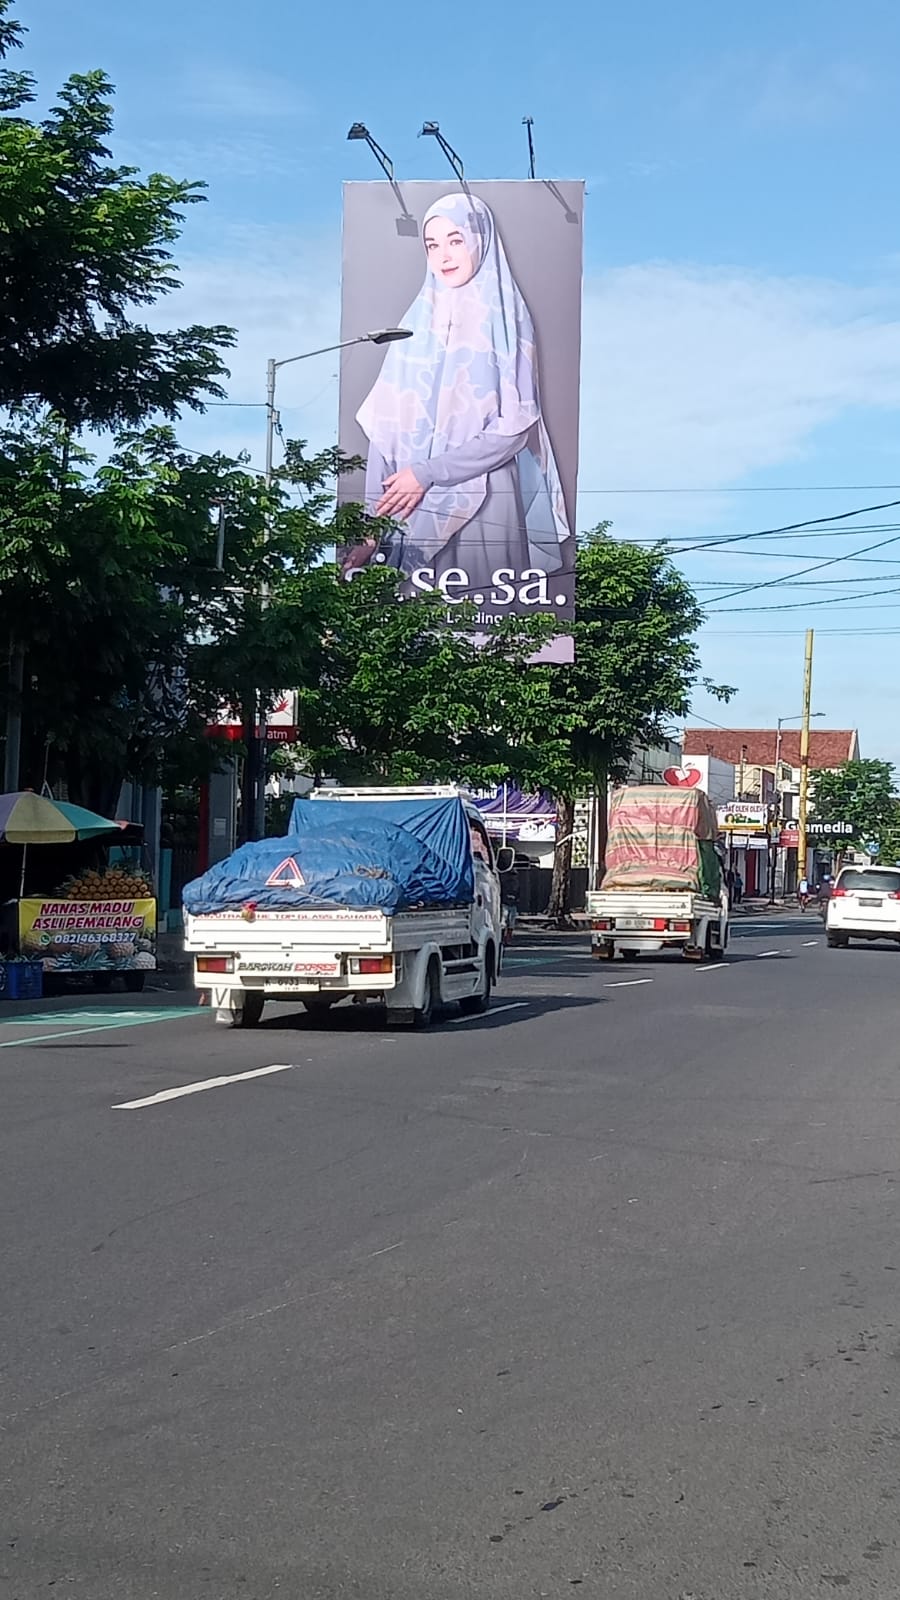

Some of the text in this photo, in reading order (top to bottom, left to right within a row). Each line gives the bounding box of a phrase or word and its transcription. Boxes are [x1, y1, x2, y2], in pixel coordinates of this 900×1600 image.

[266, 729, 288, 740] atm
[40, 902, 132, 915] NANAS MADU
[32, 915, 143, 930] ASLI PEMALANG
[54, 932, 137, 944] 082146368327
